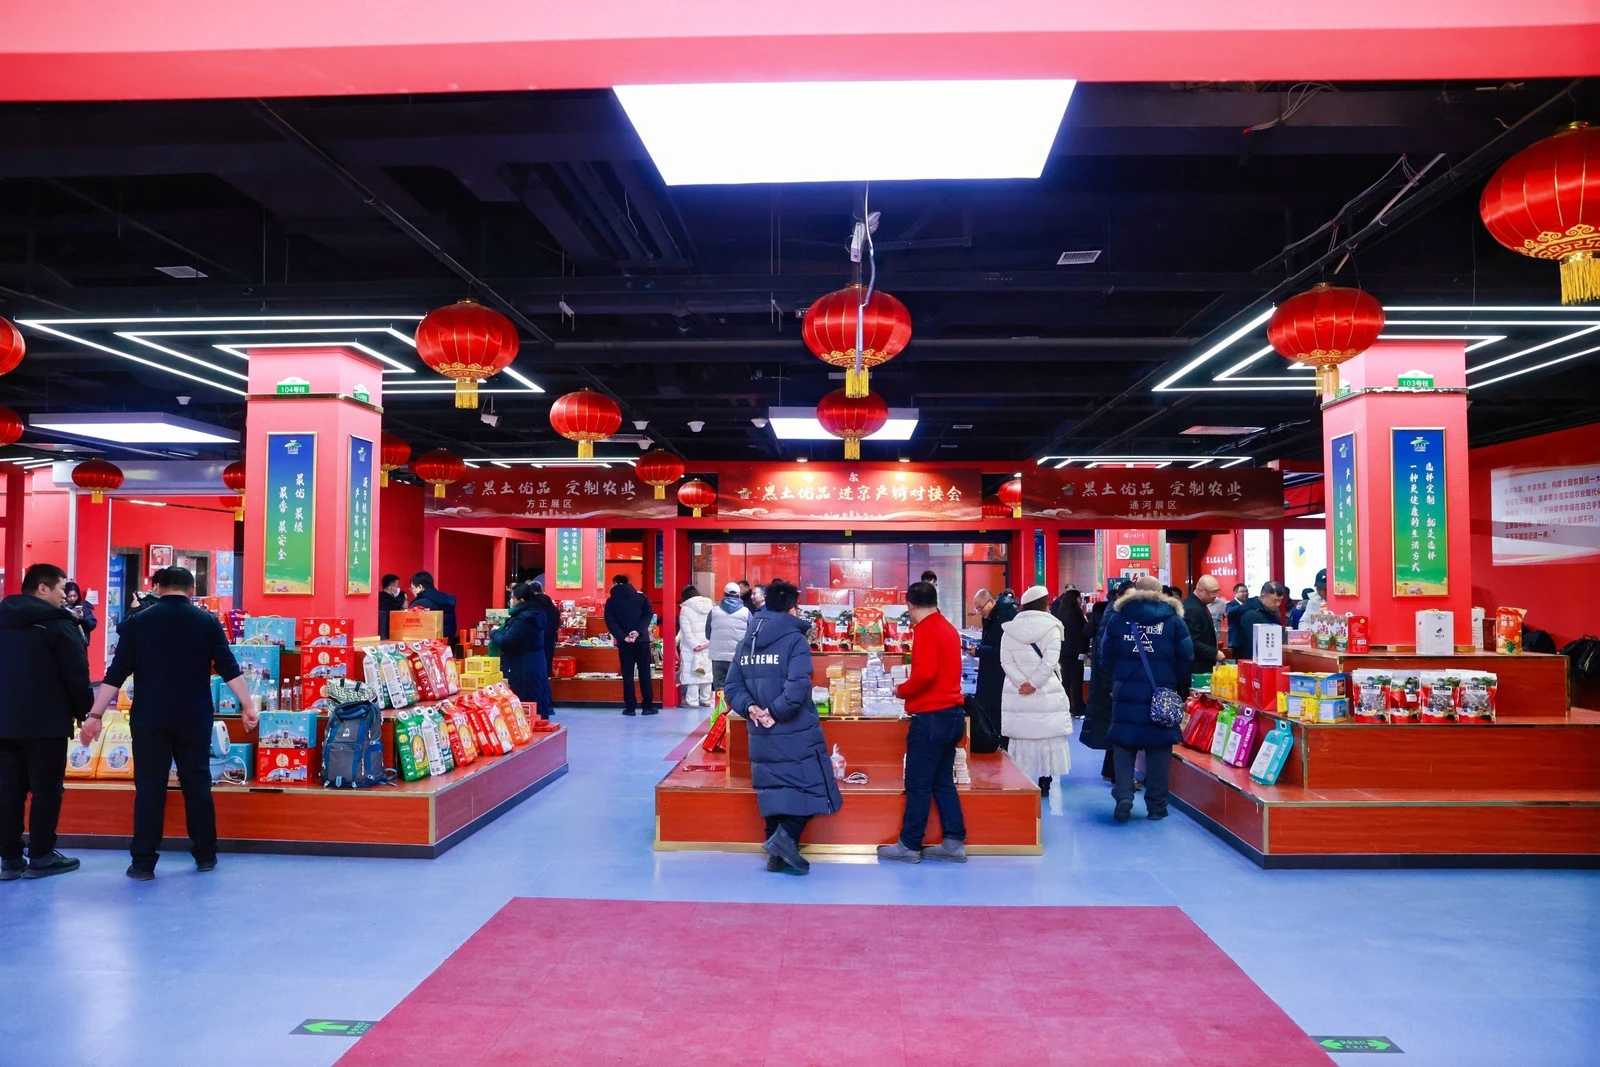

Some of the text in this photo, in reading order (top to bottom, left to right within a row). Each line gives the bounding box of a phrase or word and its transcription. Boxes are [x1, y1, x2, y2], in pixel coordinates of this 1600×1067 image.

[481, 480, 637, 496] 黑土优品 定制农业
[1081, 481, 1243, 497] 黑土优品 定制农业
[526, 499, 572, 509] 方正展区
[1129, 500, 1177, 510] 通河展区
[740, 654, 779, 665] EXTREME
